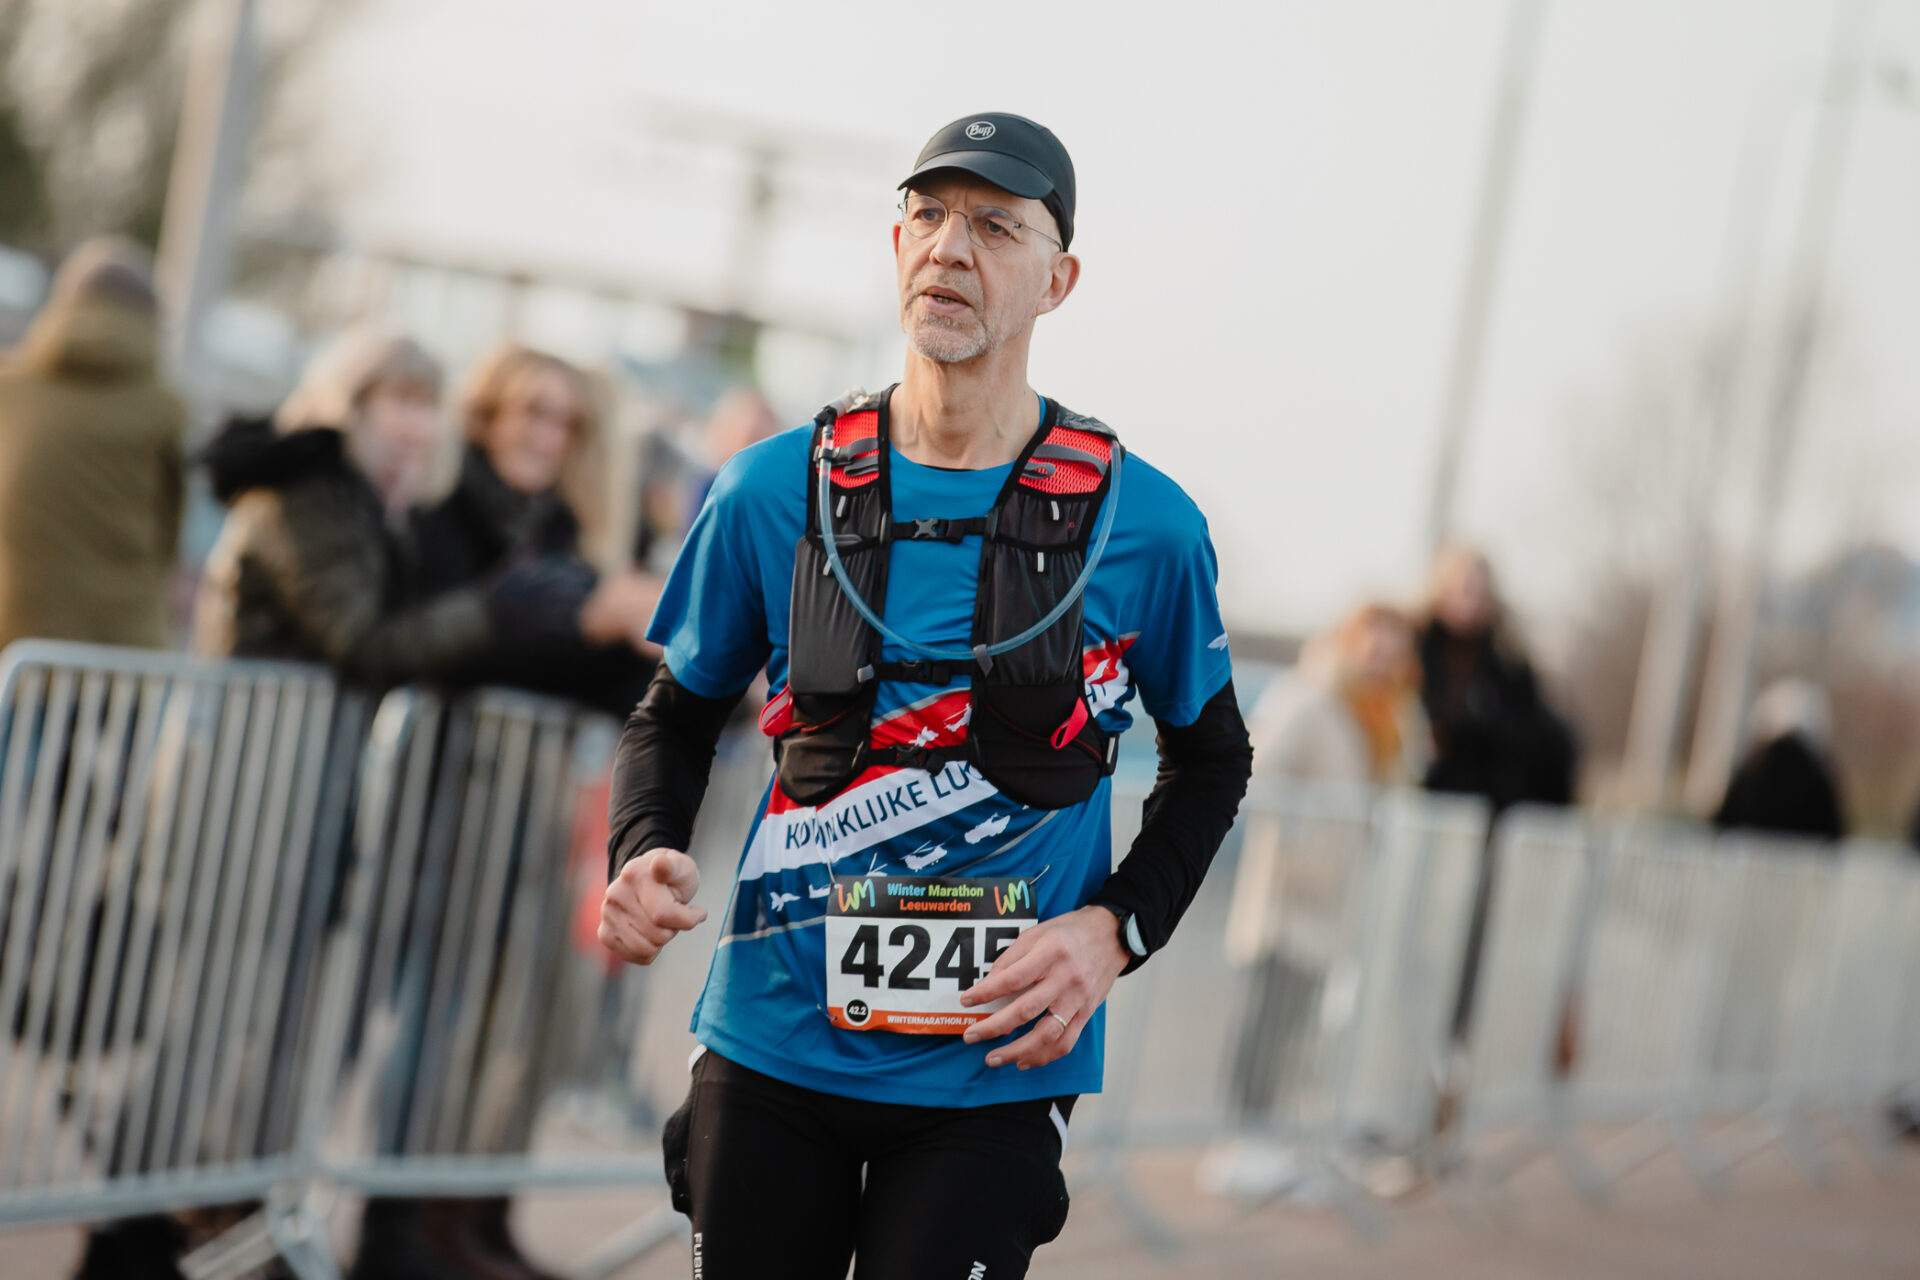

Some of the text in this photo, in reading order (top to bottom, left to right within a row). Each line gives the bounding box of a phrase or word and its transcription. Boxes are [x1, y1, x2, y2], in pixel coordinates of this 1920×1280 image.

[887, 883, 984, 897] Winter Marathon
[899, 899, 971, 912] Leeuwarden
[848, 1005, 867, 1016] 42.2
